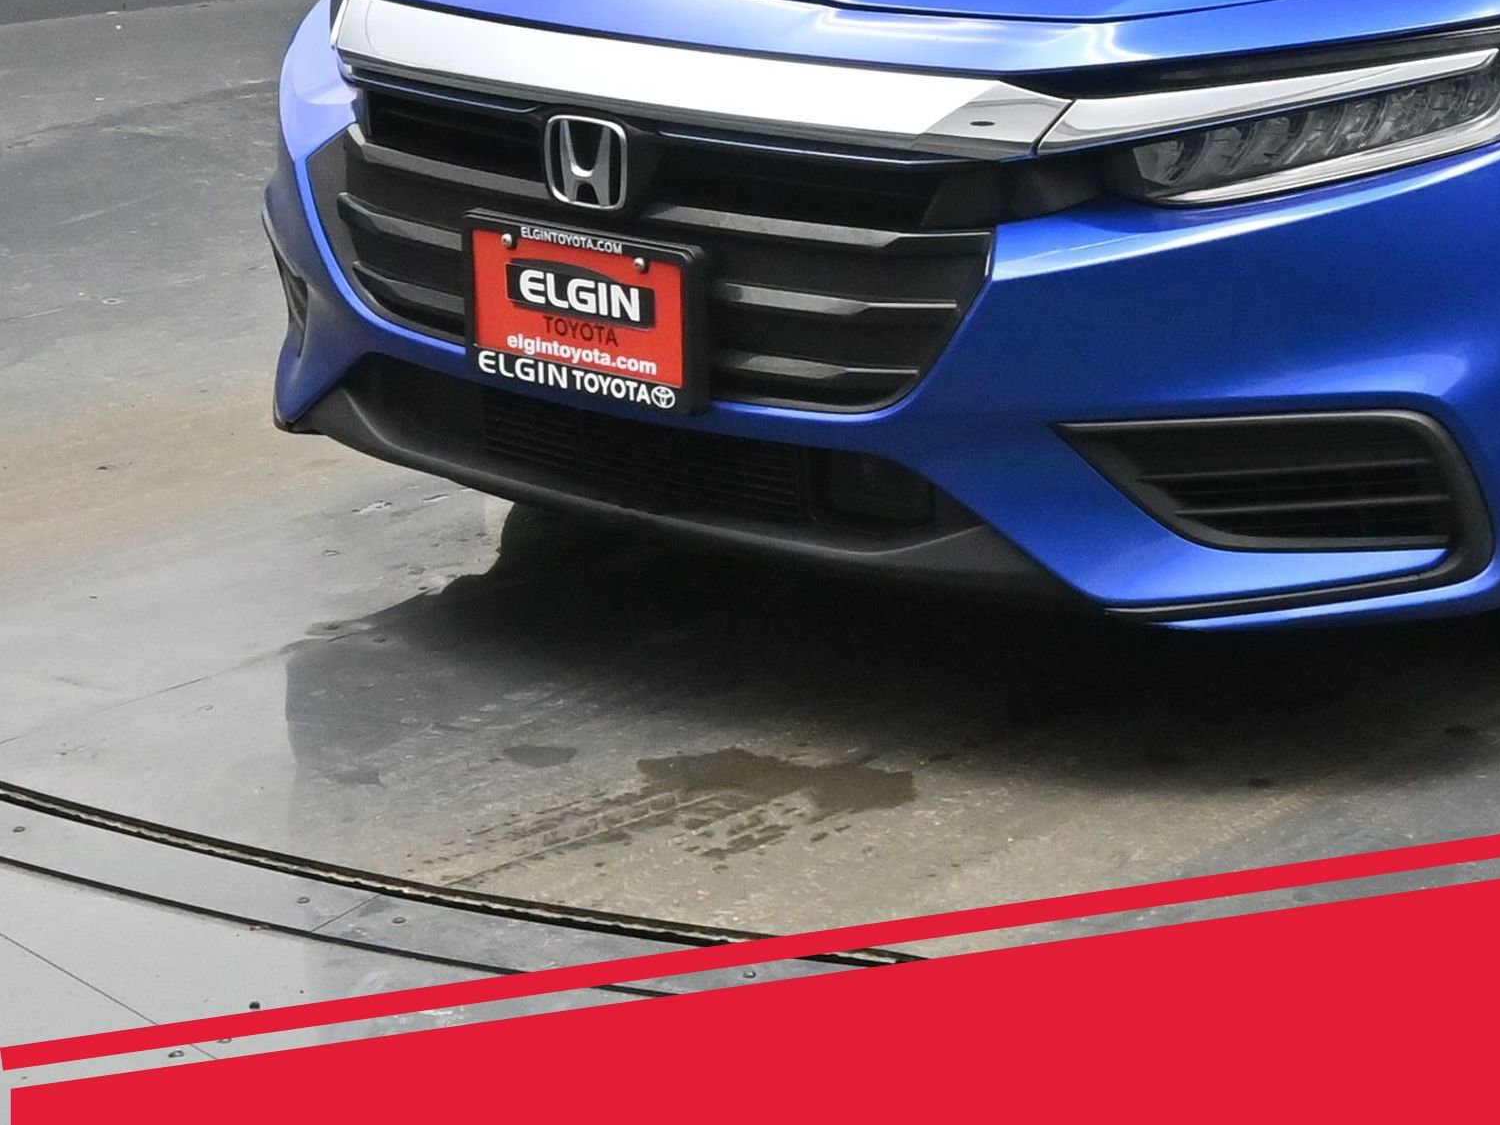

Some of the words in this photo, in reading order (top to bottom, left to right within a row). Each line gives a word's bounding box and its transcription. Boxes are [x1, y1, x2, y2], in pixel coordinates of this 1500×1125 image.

[520, 226, 623, 255] ELGINTOYOTA.COM
[519, 269, 641, 322] ELGIN
[543, 315, 619, 347] TOYOTA
[507, 333, 657, 375] elgintoyota.com
[478, 350, 568, 388] ELGIN
[572, 370, 651, 404] TOYOTA
